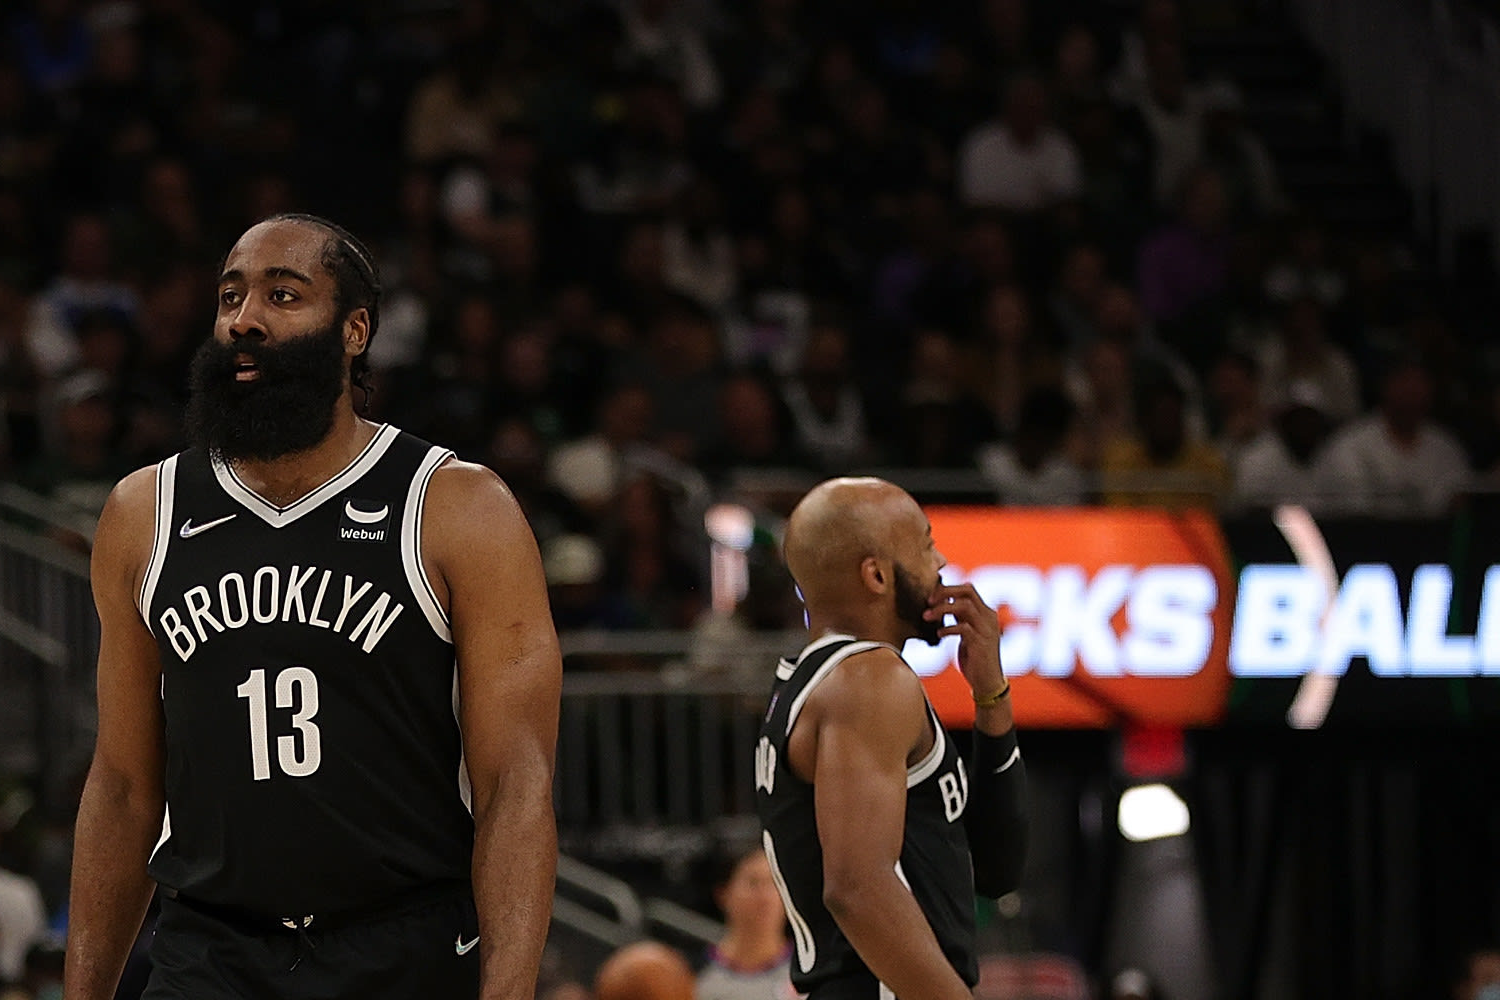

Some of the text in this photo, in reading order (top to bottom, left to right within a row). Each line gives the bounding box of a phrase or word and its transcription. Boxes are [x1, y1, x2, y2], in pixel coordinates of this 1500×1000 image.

[341, 527, 385, 541] Webull
[160, 565, 404, 662] BROOKLYN
[900, 564, 1219, 678] CKS
[237, 667, 321, 781] 13
